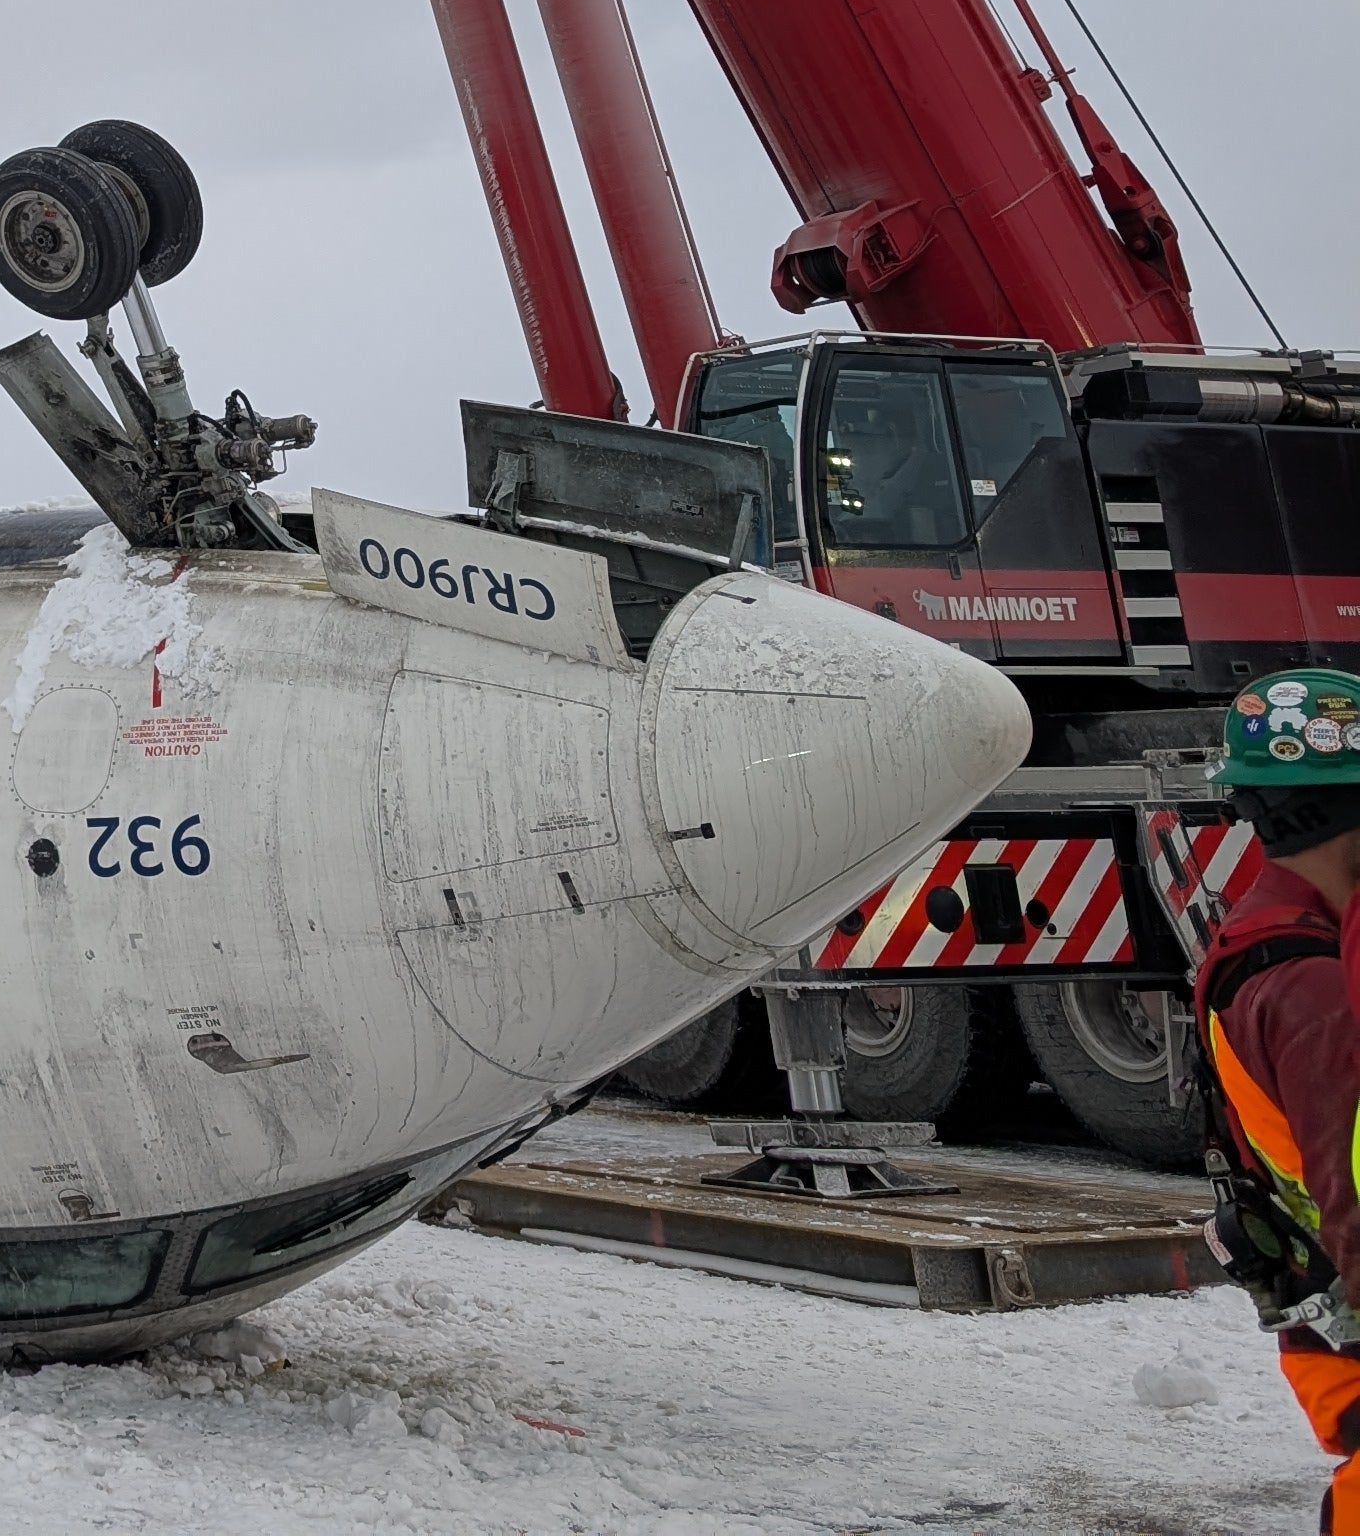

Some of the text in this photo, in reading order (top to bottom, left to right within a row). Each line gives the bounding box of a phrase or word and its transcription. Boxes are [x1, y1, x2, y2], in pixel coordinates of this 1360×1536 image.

[359, 537, 556, 622] CRJ900
[948, 596, 1077, 622] MAMMOET
[144, 744, 201, 757] CAUTION
[85, 815, 212, 878] 932
[176, 1020, 202, 1030] STEP
